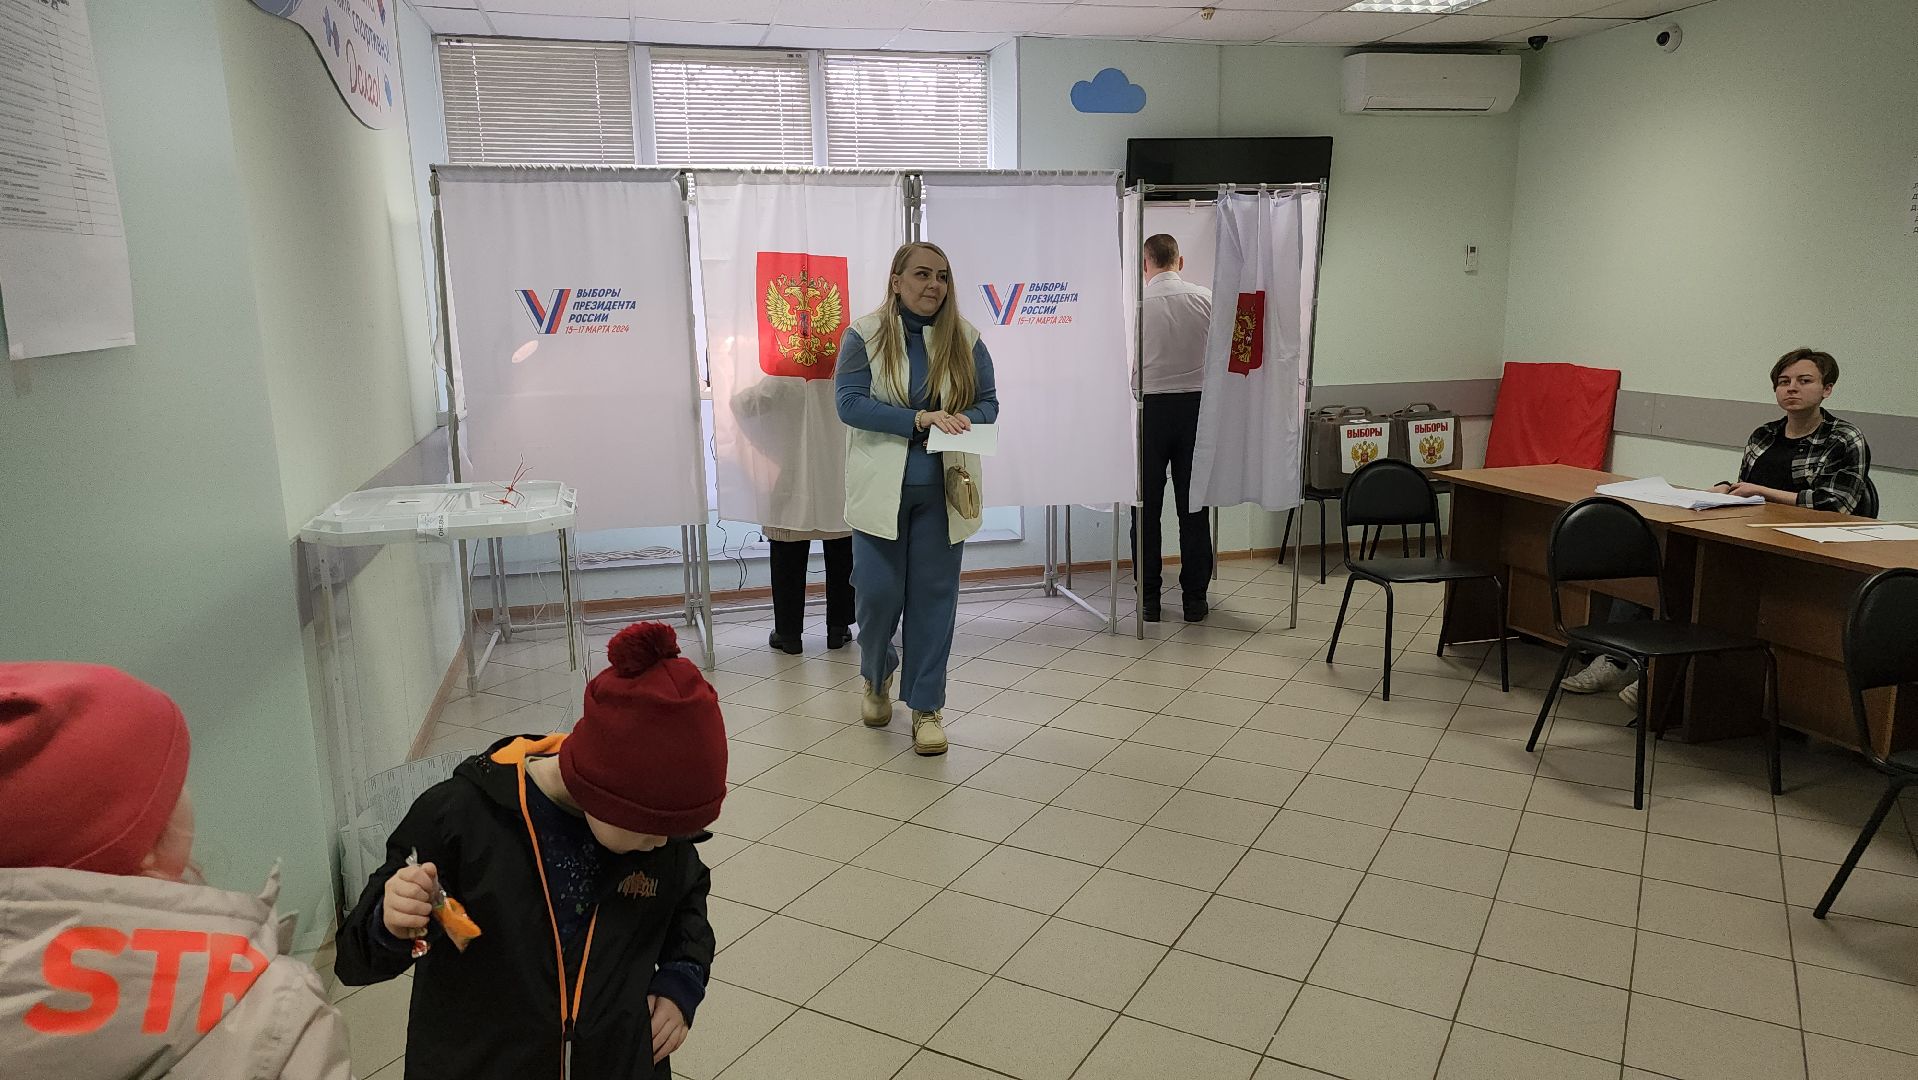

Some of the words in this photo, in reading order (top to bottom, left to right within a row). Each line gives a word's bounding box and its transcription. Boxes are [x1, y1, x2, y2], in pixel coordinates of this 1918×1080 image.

[1029, 282, 1068, 292] ВЫБОРЫ
[576, 288, 621, 298] ВЫБОРЫ
[1024, 293, 1079, 304] ПРЕЗИДЕНТА
[572, 300, 636, 311] ПРЕЗИДЕНТА
[1021, 305, 1056, 315] РОССИИ
[568, 313, 609, 324] РОССИИ
[1036, 316, 1057, 325] МАРТА
[1058, 315, 1073, 324] 2024
[585, 325, 610, 334] МАРТА
[611, 324, 630, 333] 2024
[1346, 427, 1382, 438] ВЫБОРЫ
[1414, 422, 1448, 434] ВЫБОРЫ
